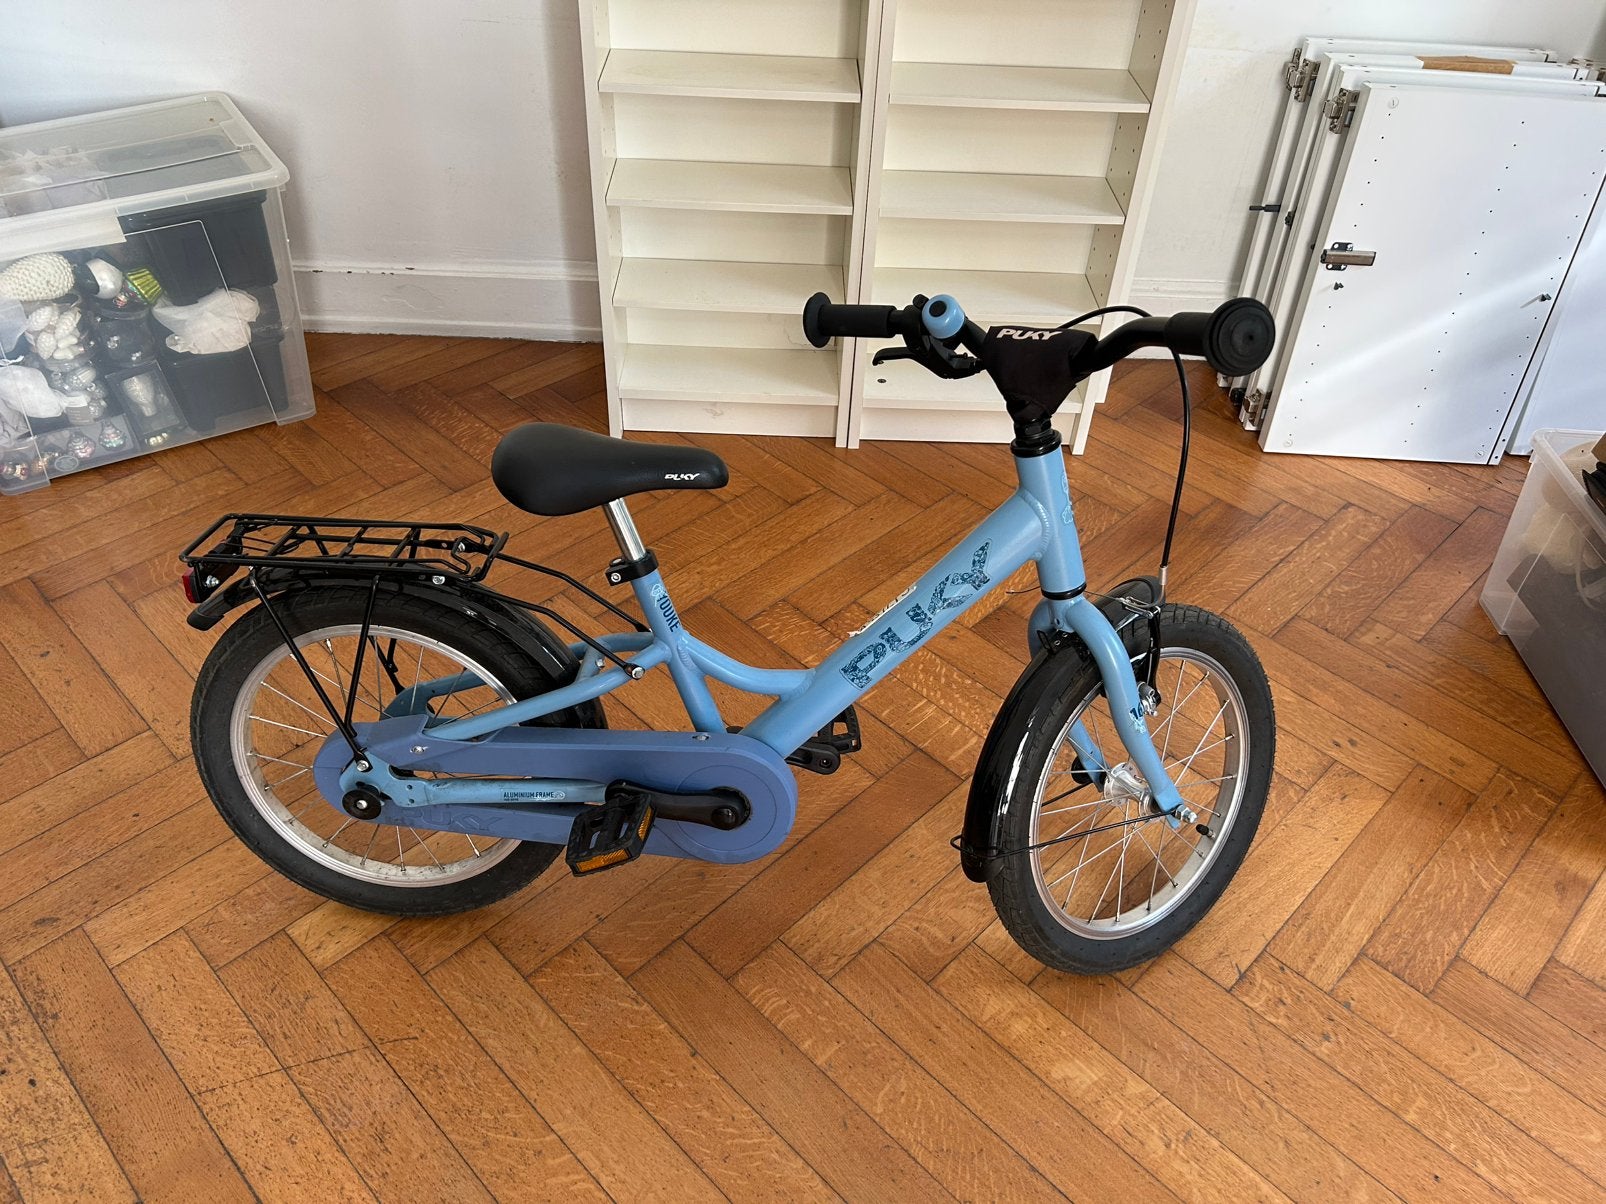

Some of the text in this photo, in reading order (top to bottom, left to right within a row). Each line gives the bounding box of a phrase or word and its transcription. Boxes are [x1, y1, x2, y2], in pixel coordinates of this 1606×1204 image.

[996, 328, 1063, 340] PUKY
[664, 473, 701, 481] PUKY
[840, 541, 991, 689] PUKY
